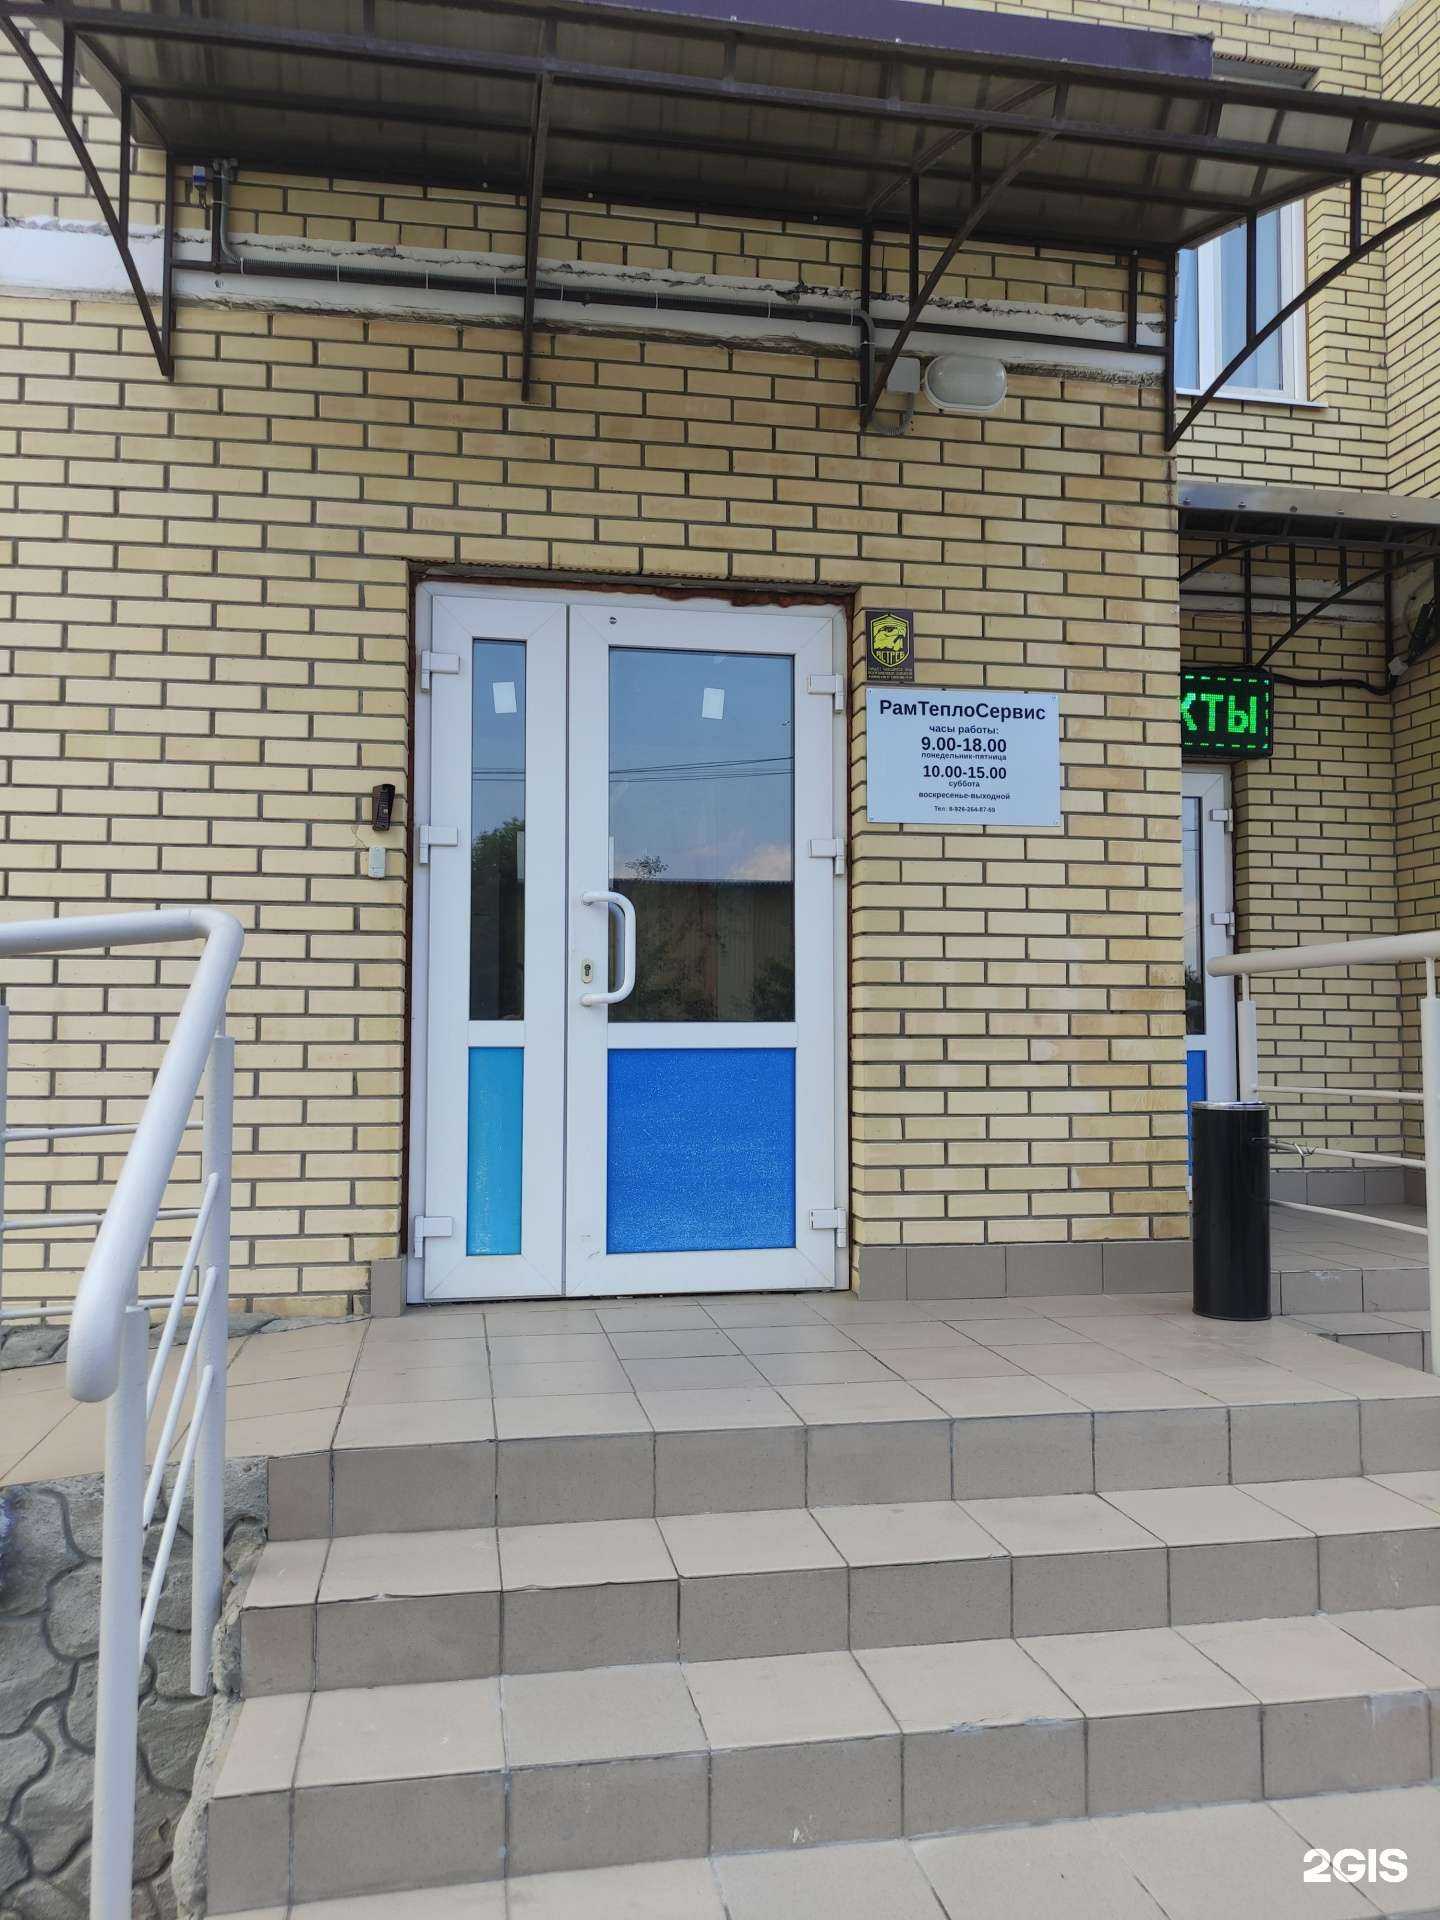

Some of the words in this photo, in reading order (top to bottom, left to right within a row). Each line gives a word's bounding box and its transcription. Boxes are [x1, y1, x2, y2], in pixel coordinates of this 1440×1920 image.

[879, 699, 1046, 722] РамТеплоСервис
[929, 725, 955, 733] часы
[958, 725, 1000, 735] работы:
[921, 736, 1007, 753] 9.00-18.00
[921, 752, 1007, 761] понедельник-пятница
[923, 765, 1007, 779] 10.00-15.00
[948, 780, 980, 789] суббота
[918, 790, 1010, 801] воскресенье-выходной
